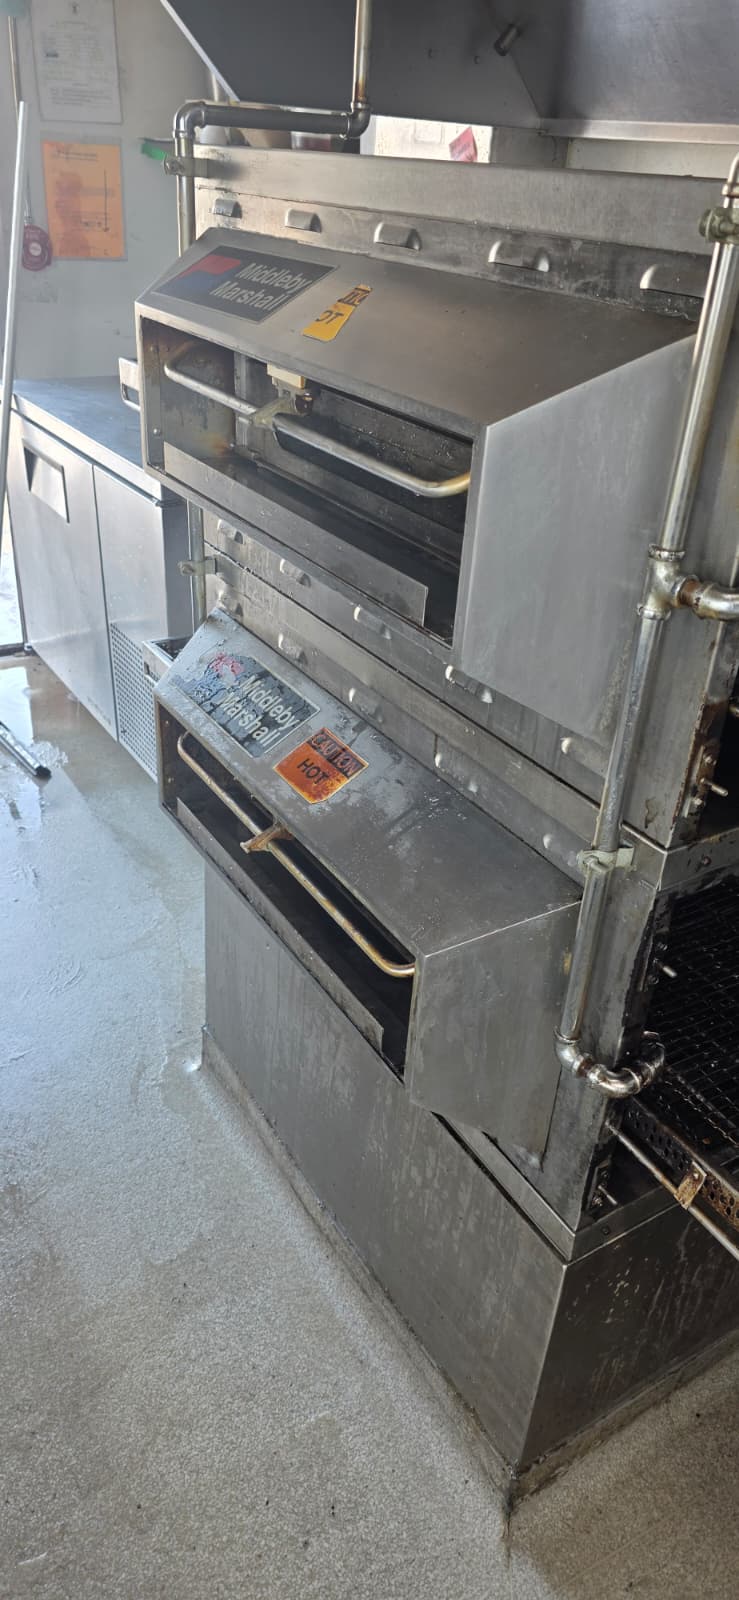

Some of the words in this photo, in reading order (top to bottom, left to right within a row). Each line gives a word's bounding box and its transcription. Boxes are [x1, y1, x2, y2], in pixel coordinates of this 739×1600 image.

[210, 281, 286, 310] Marshall
[235, 263, 312, 293] Middleby
[220, 692, 280, 747] Marshall
[240, 675, 300, 731] Middleby
[297, 758, 330, 785] HOT
[311, 733, 359, 777] CAUTION
